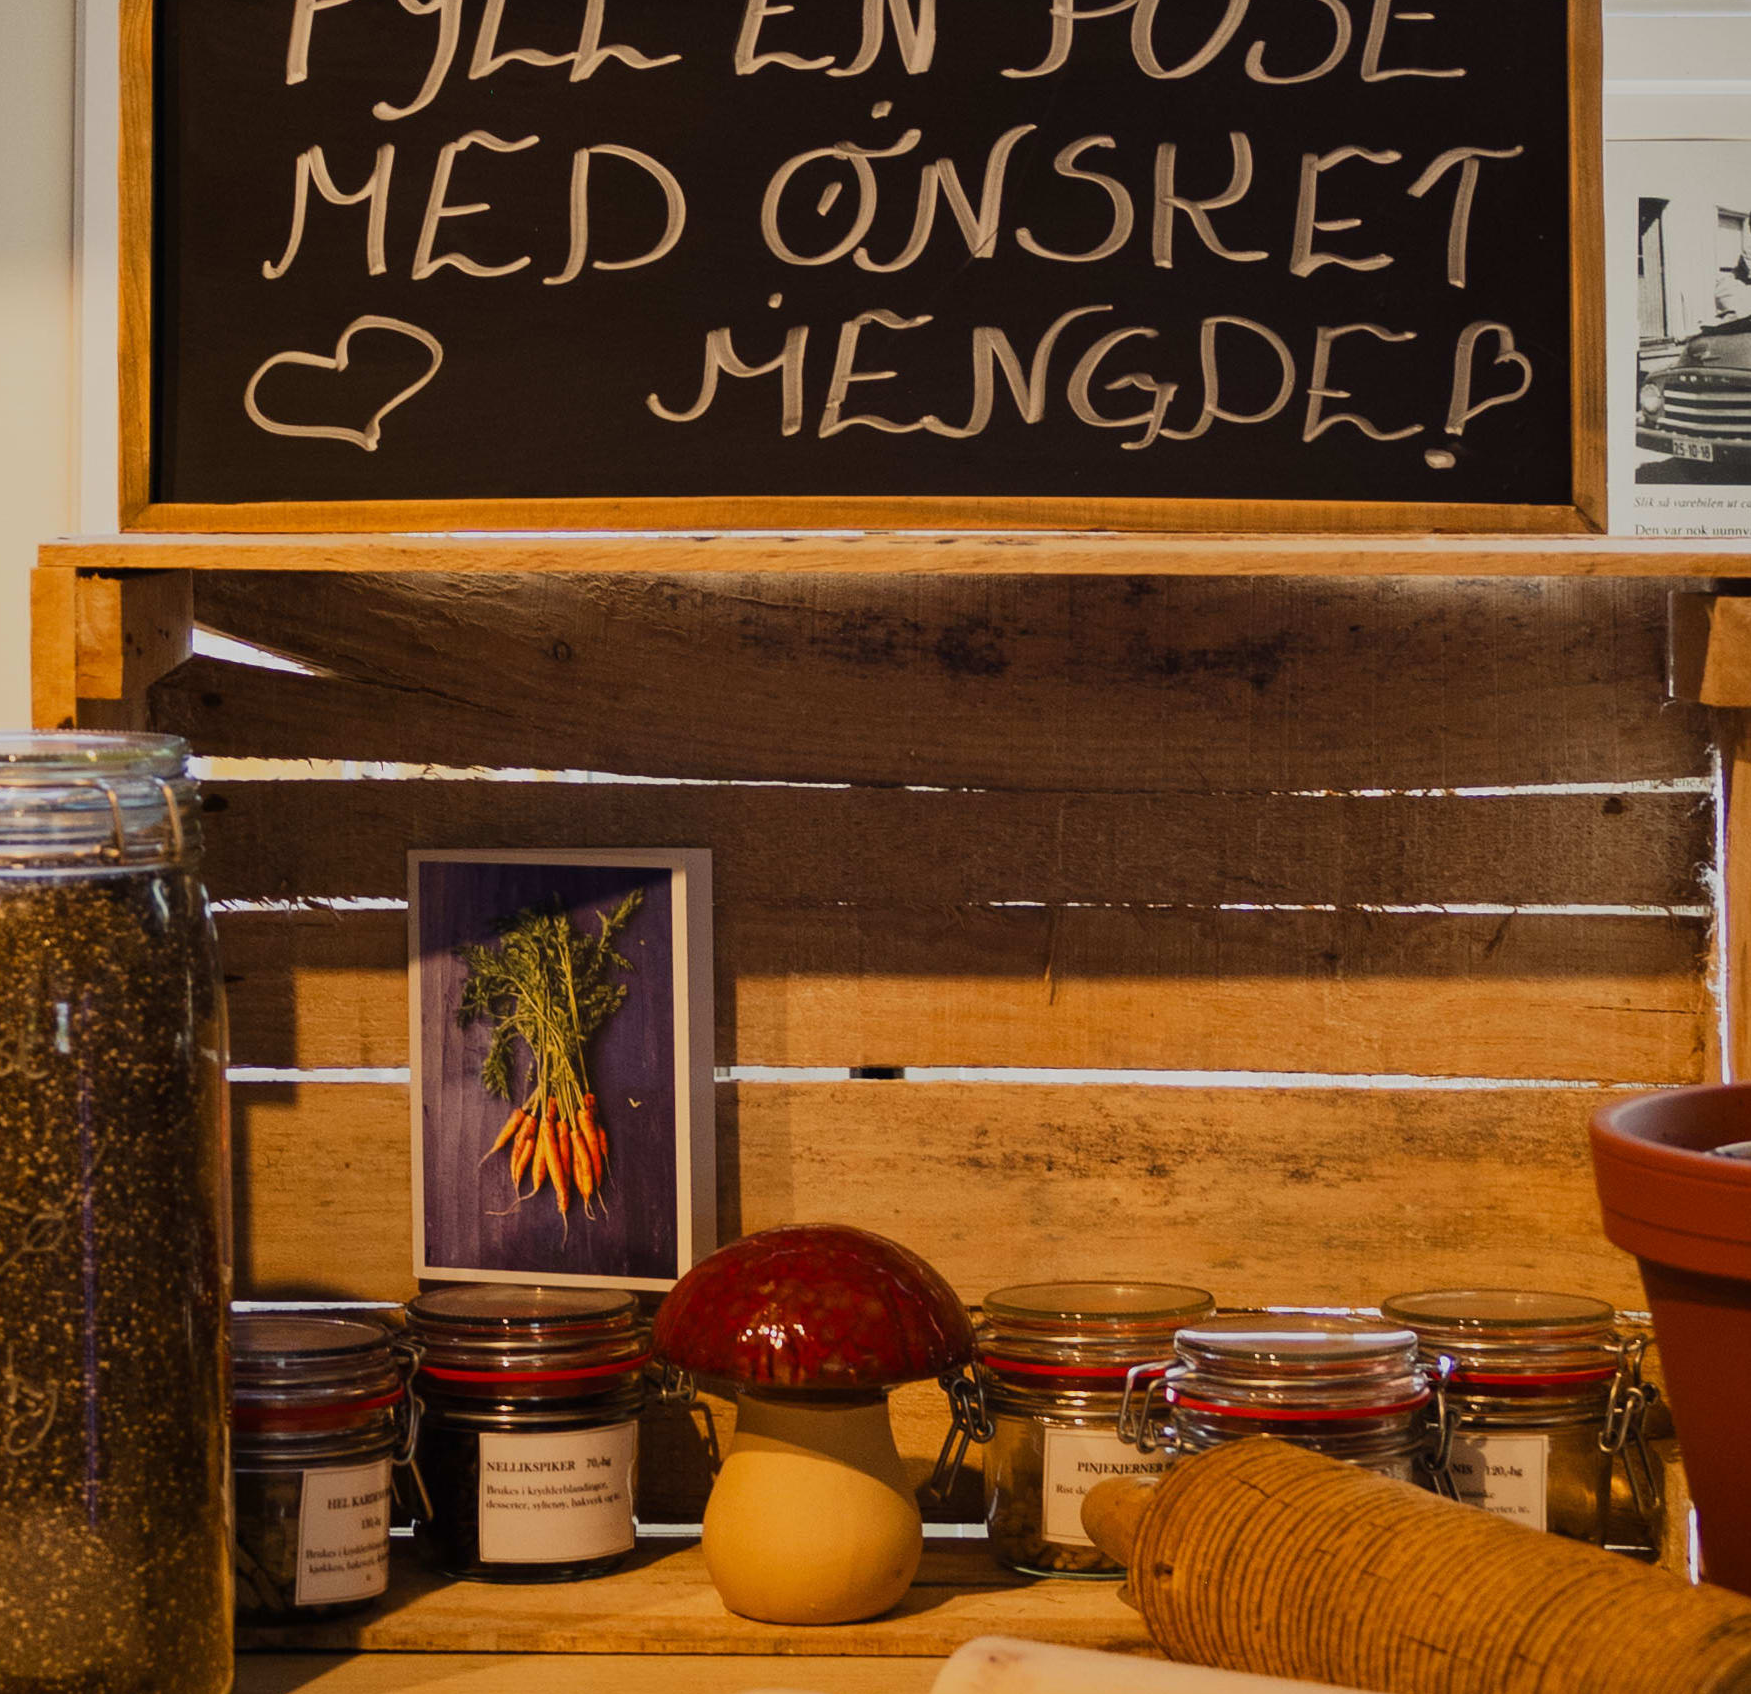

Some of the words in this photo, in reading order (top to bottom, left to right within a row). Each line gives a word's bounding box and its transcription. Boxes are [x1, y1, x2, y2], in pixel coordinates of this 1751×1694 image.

[263, 130, 688, 285] MED
[758, 99, 1525, 309] ØNSKET
[1634, 496, 1654, 508] Slik
[1673, 497, 1724, 509] varebilen
[1726, 499, 1738, 509] ut
[486, 1460, 576, 1473] NELLIKSPIKER
[1077, 1461, 1164, 1475] PINJEKJERNER
[1451, 1462, 1474, 1476] NIS
[486, 1484, 520, 1496] Brukes
